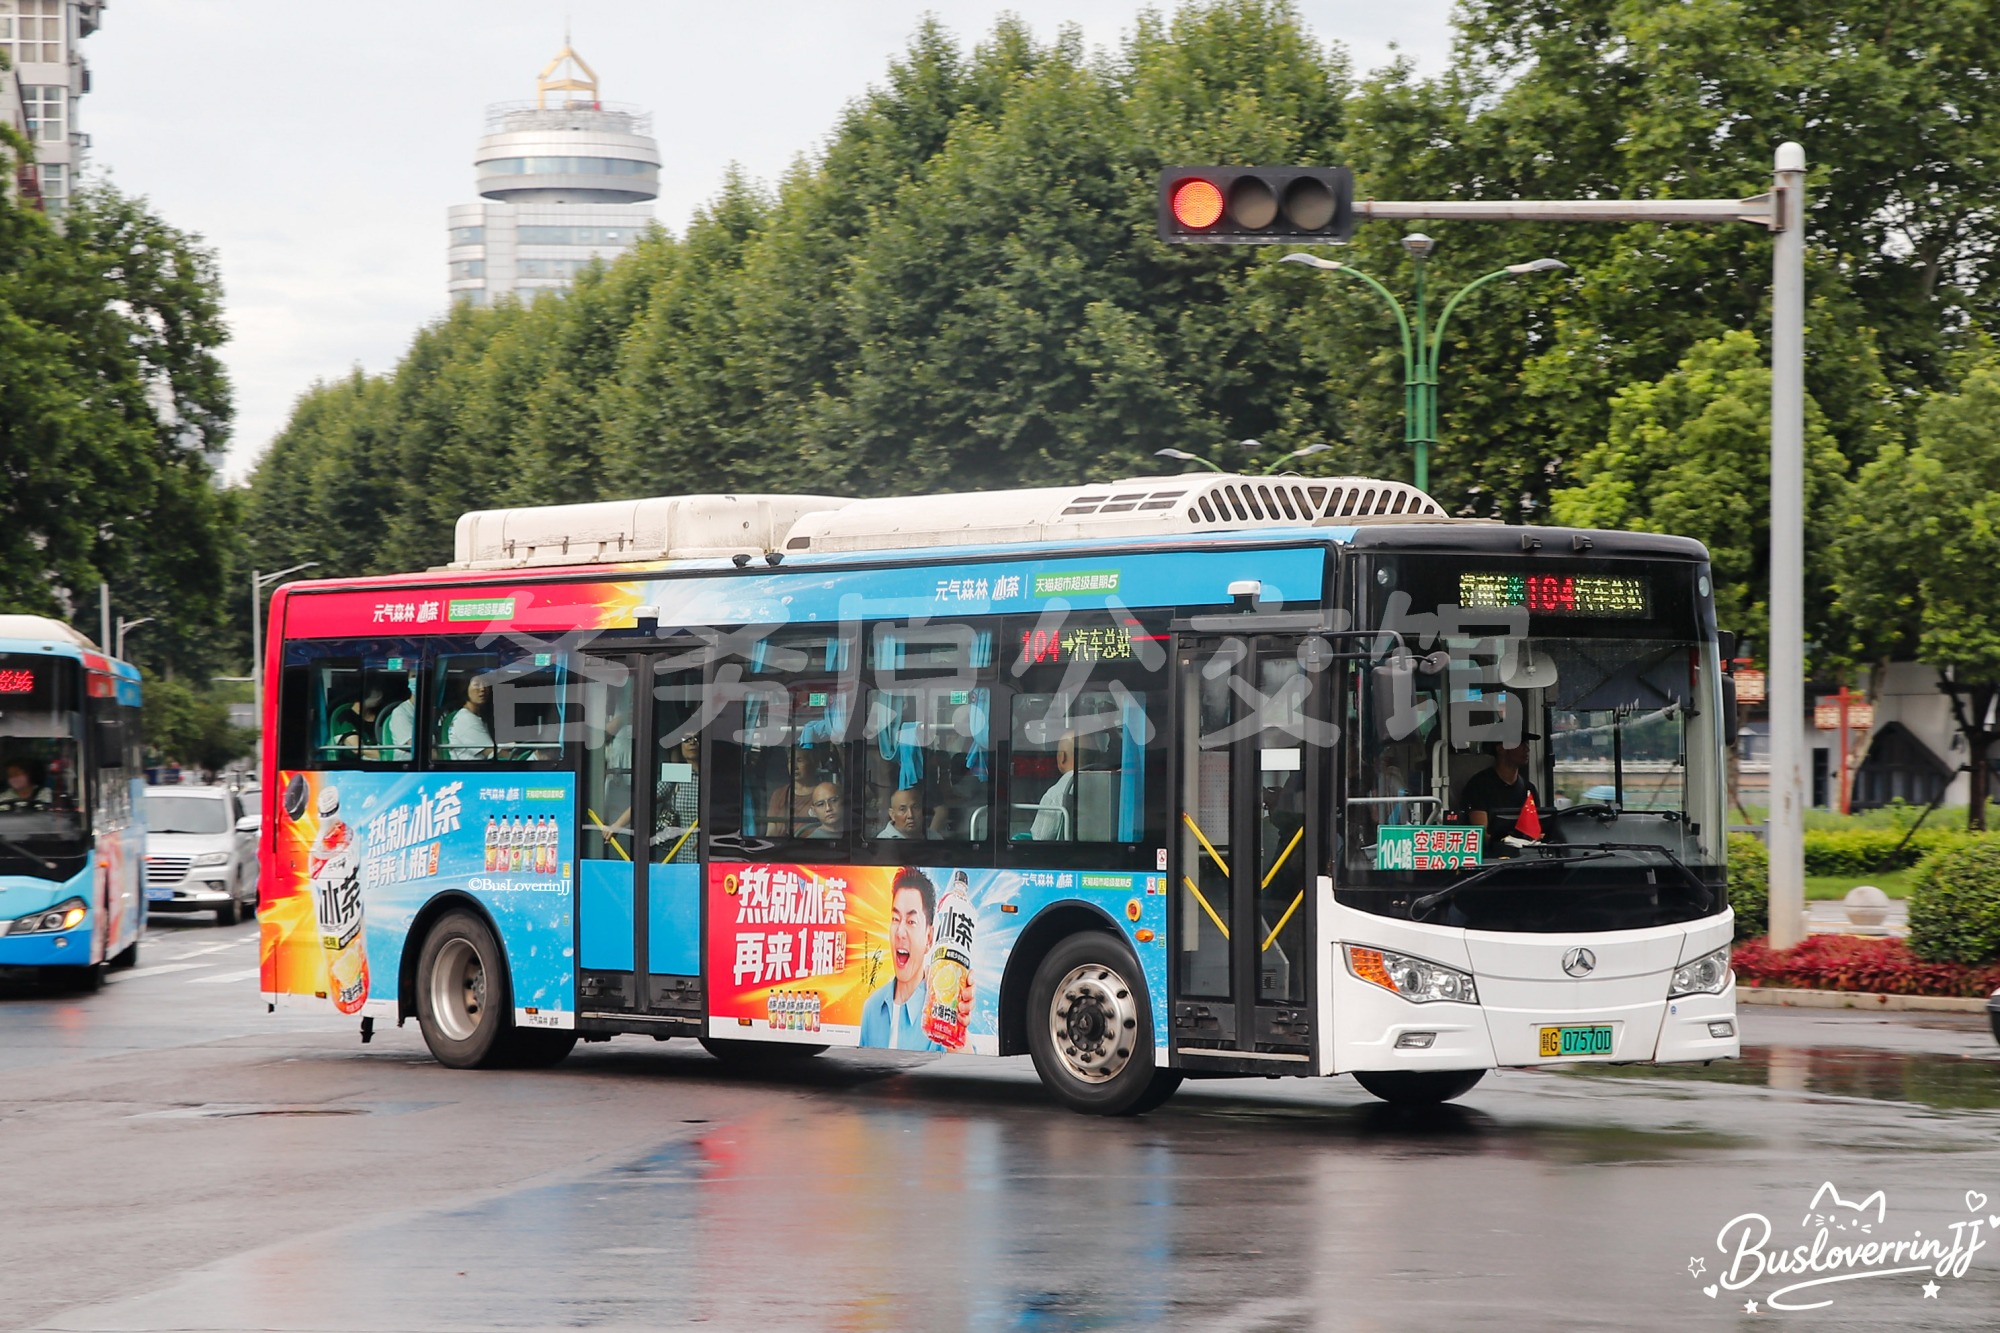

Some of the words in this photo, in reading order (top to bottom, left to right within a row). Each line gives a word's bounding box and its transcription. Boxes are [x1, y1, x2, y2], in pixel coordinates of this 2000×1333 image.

[934, 579, 988, 601] 元气森林
[991, 575, 1020, 600] 冰茶
[1527, 576, 1575, 611] 104
[373, 603, 415, 623] 元气森林
[1021, 629, 1061, 663] 104
[1074, 627, 1132, 662] 汽车总站
[367, 780, 464, 860] 热就冰茶
[1381, 838, 1413, 870] 104路
[1413, 829, 1480, 854] 空调开启
[366, 844, 430, 890] 再来1瓶
[1021, 873, 1054, 888] 元气森林
[735, 863, 848, 925] 热就冰茶
[936, 906, 975, 953] 冰茶
[733, 927, 835, 986] 再来1瓶
